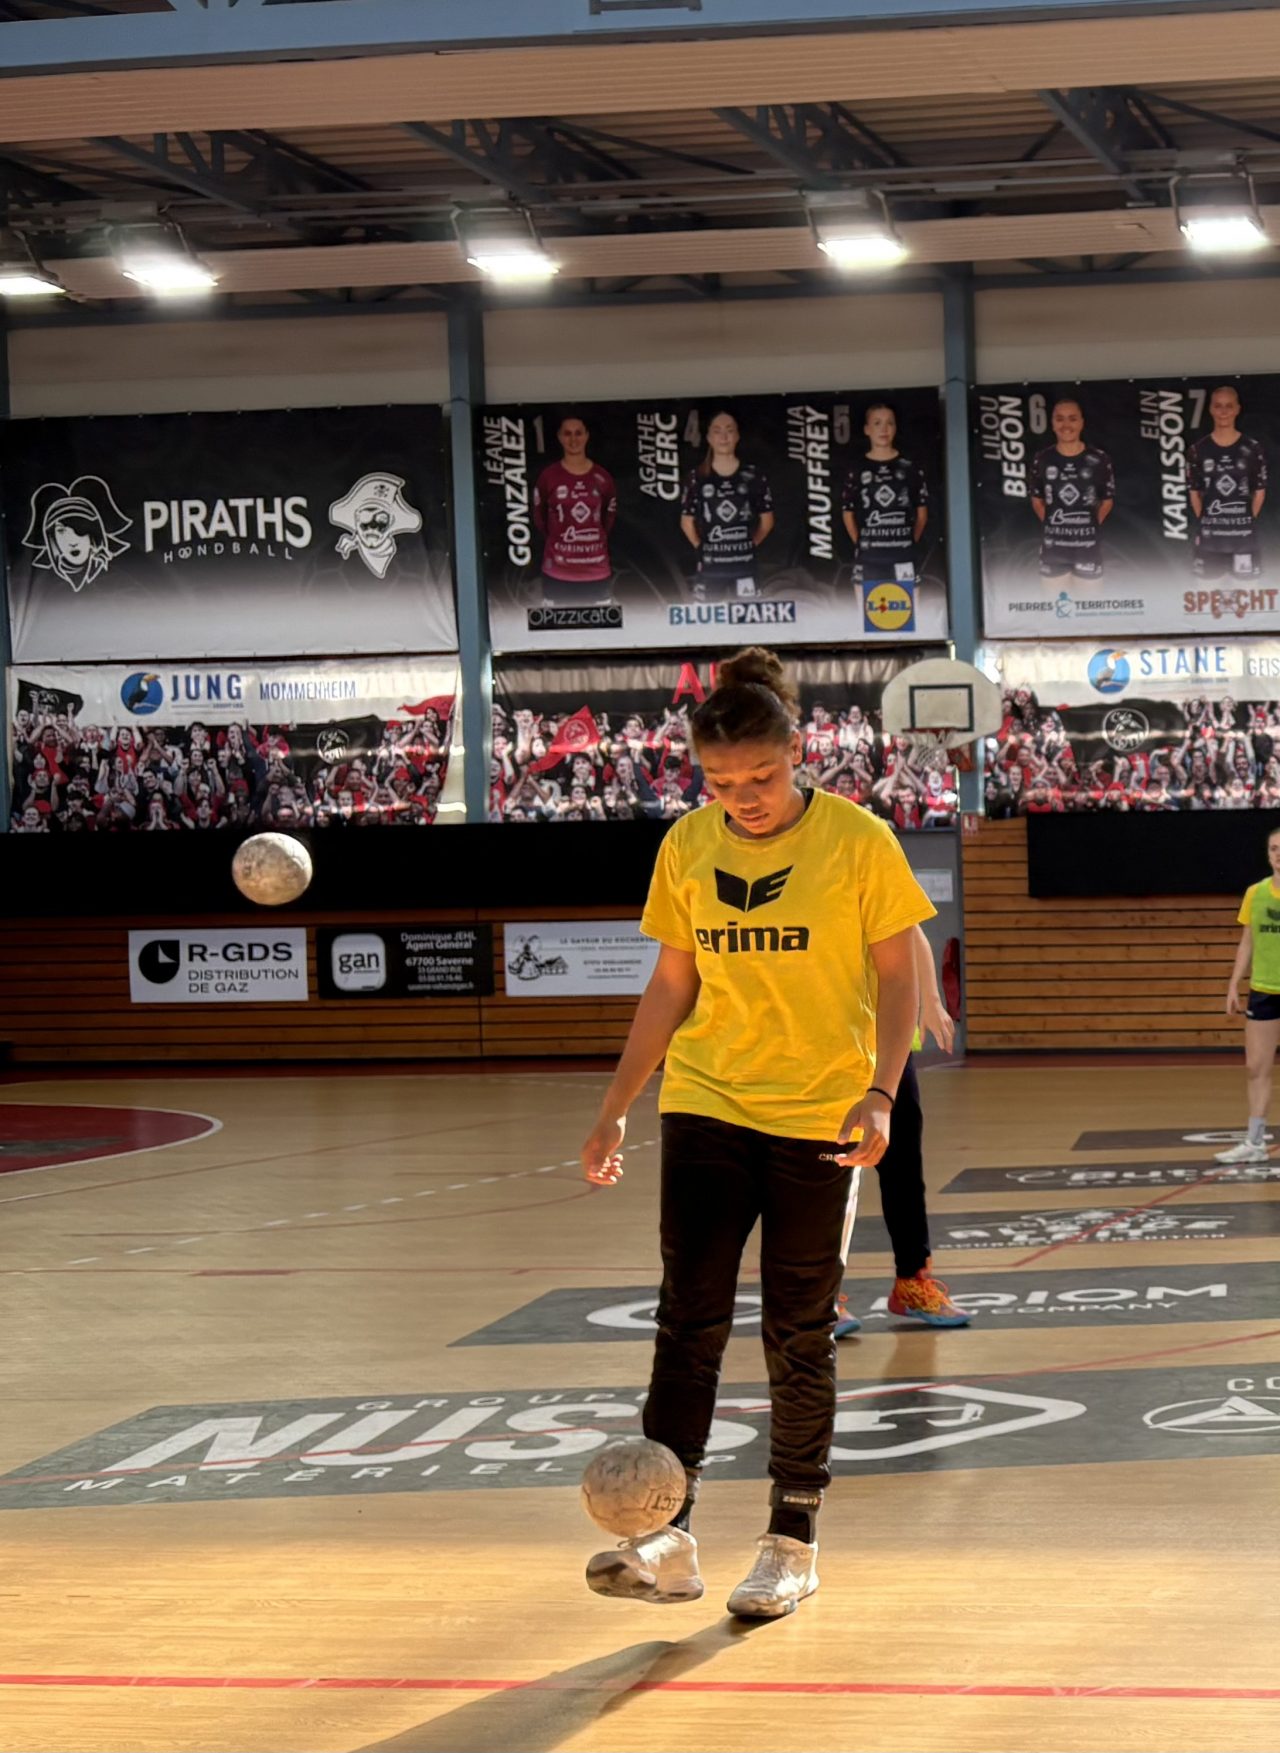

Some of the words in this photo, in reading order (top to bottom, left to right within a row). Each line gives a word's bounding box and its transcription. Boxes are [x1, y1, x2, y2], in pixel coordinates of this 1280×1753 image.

[683, 409, 702, 448] 4
[833, 405, 850, 445] 5
[979, 396, 1002, 460] LILOU
[1028, 393, 1048, 434] 6
[1139, 390, 1160, 440] ELIN
[1188, 388, 1207, 429] 7
[483, 415, 505, 485] LÉANE
[533, 415, 545, 453] 1
[786, 405, 807, 465] JULIA
[998, 395, 1028, 498] BEGON
[637, 412, 658, 498] AGATHE
[654, 412, 681, 501] CLERC
[1158, 390, 1189, 541] KARLSSON
[501, 415, 532, 567] GONZALEZ
[805, 404, 833, 560] MAUFFREY
[143, 496, 313, 553] PIRATHS
[1008, 601, 1054, 612] PIERRES
[1075, 598, 1145, 611] TERRITOIRES
[1139, 646, 1227, 676] STANE
[171, 673, 242, 701] JUNG
[259, 680, 356, 701] MOMMENHEIM
[187, 942, 293, 962] R-GDS
[695, 921, 810, 954] erima
[187, 968, 299, 981] DISTRIBUTION
[338, 951, 380, 974] gan
[188, 982, 210, 994] DE
[214, 982, 249, 994] GAZ
[991, 1301, 1180, 1315] COMPANY
[62, 1461, 565, 1491] MATERIEL
